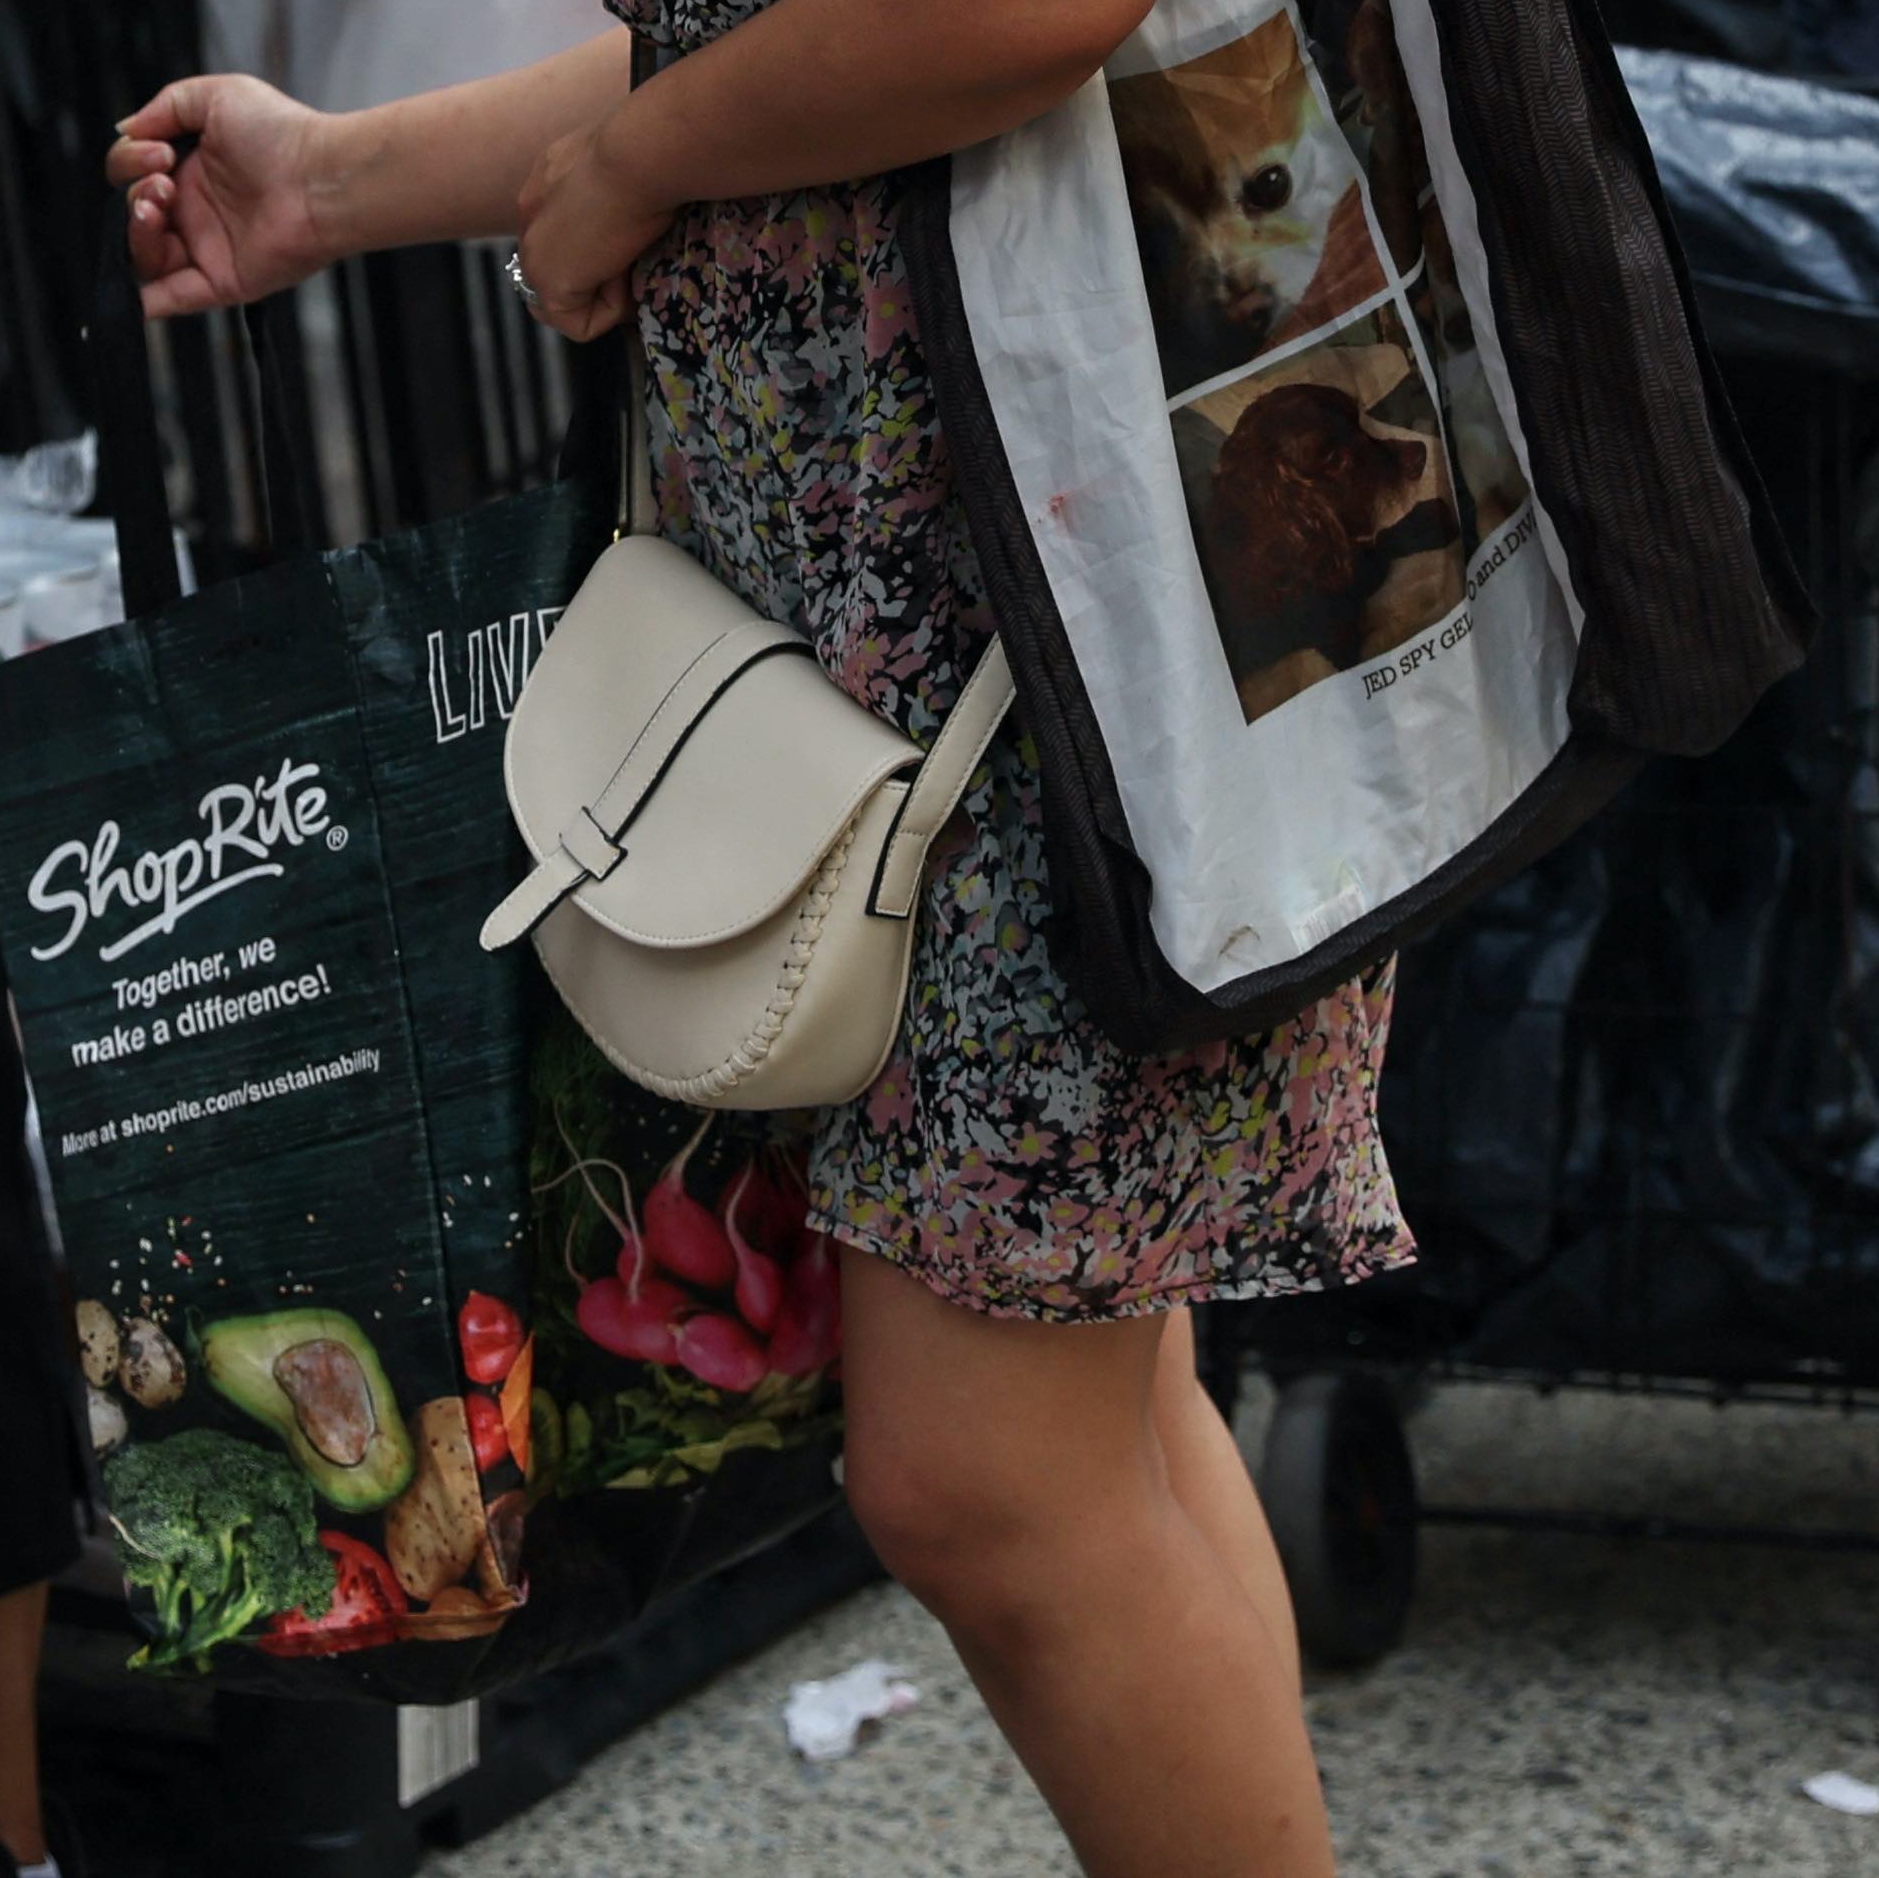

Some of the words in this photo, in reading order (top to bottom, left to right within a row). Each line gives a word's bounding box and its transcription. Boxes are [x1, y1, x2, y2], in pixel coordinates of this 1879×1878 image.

[1361, 665, 1397, 700] JED
[1399, 639, 1436, 676] SPY
[1476, 545, 1506, 588] and
[1504, 506, 1538, 555] DIV
[27, 757, 330, 961] ShopRite
[72, 1025, 146, 1067] make
[153, 1018, 171, 1045] a
[177, 963, 332, 1038] difference!
[112, 949, 231, 1009] Together,
[238, 937, 277, 970] we
[62, 1130, 99, 1158] More
[100, 1120, 118, 1144] at
[120, 1047, 381, 1138] shoprite.com/sustainability
